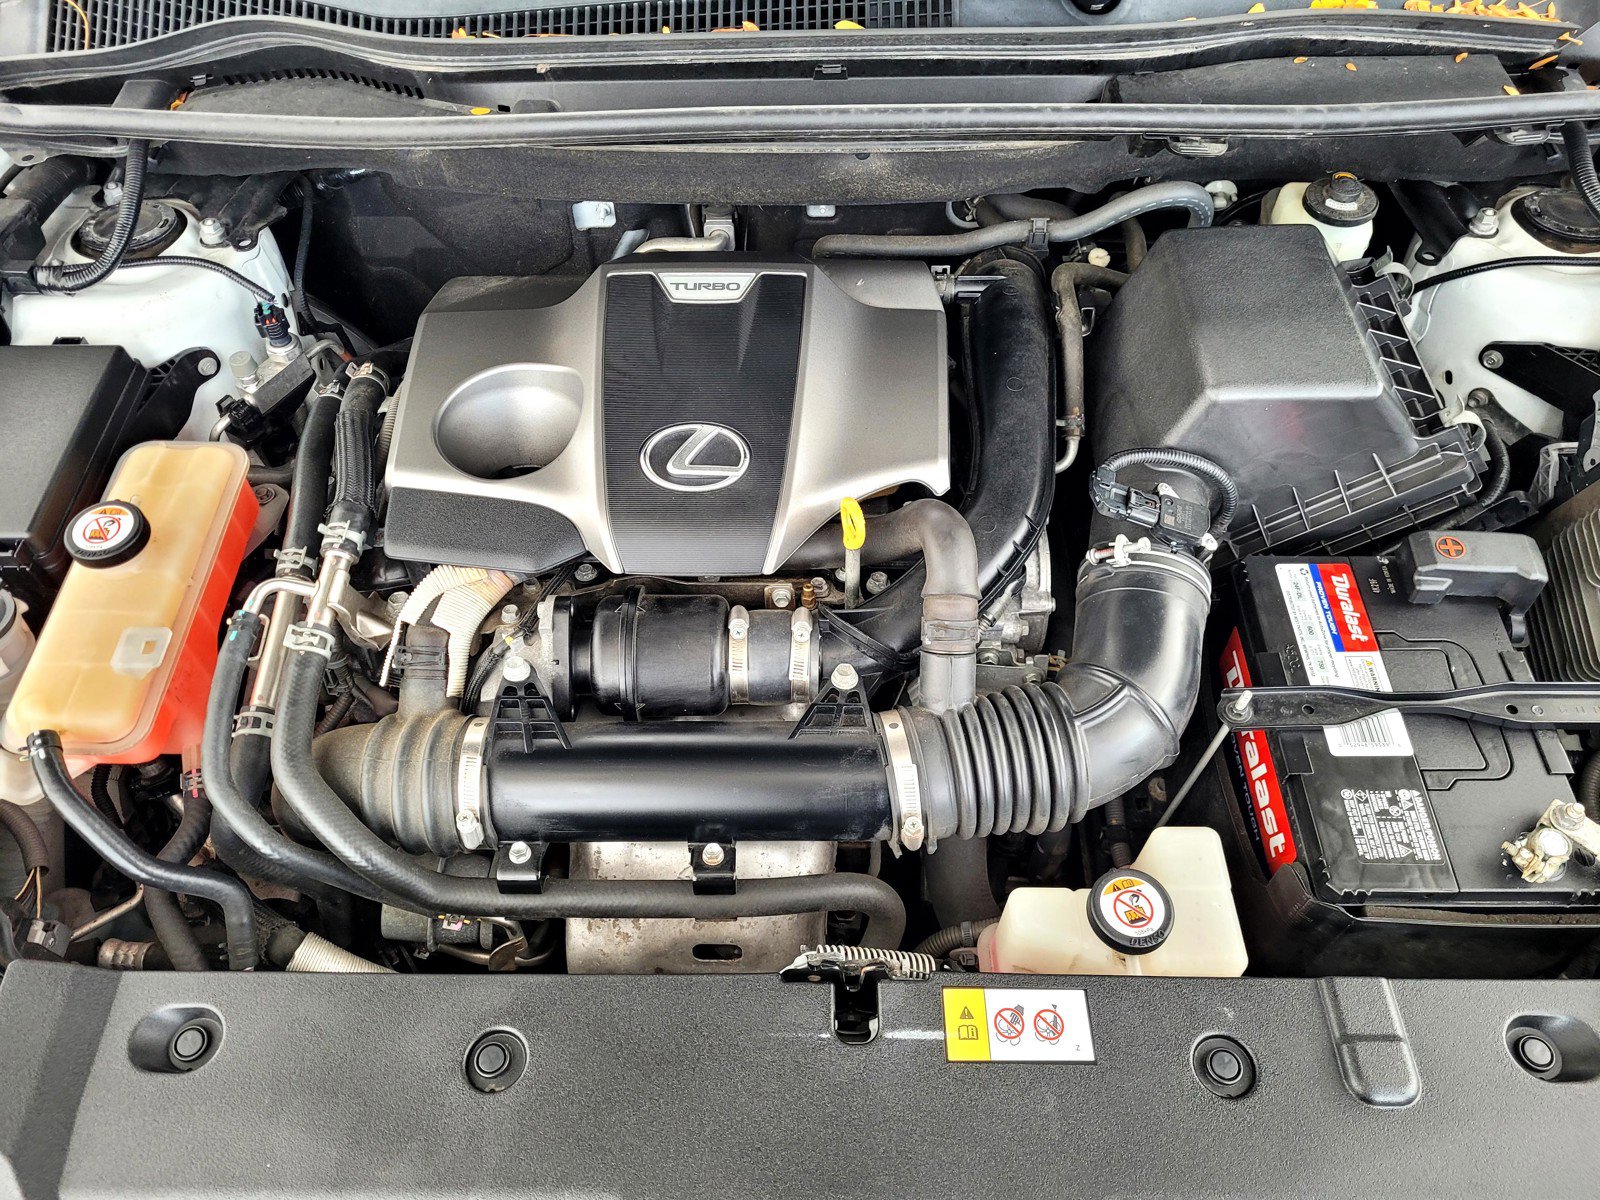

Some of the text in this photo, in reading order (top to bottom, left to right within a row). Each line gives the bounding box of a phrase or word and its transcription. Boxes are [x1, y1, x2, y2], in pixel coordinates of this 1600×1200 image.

[670, 282, 740, 290] TURBO
[1293, 582, 1302, 599] 24F-DL
[1316, 582, 1338, 635] PROVEN TOUGH
[1330, 574, 1368, 642] Duralast
[1369, 668, 1380, 692] WARNIN
[1130, 930, 1165, 946] DENSO
